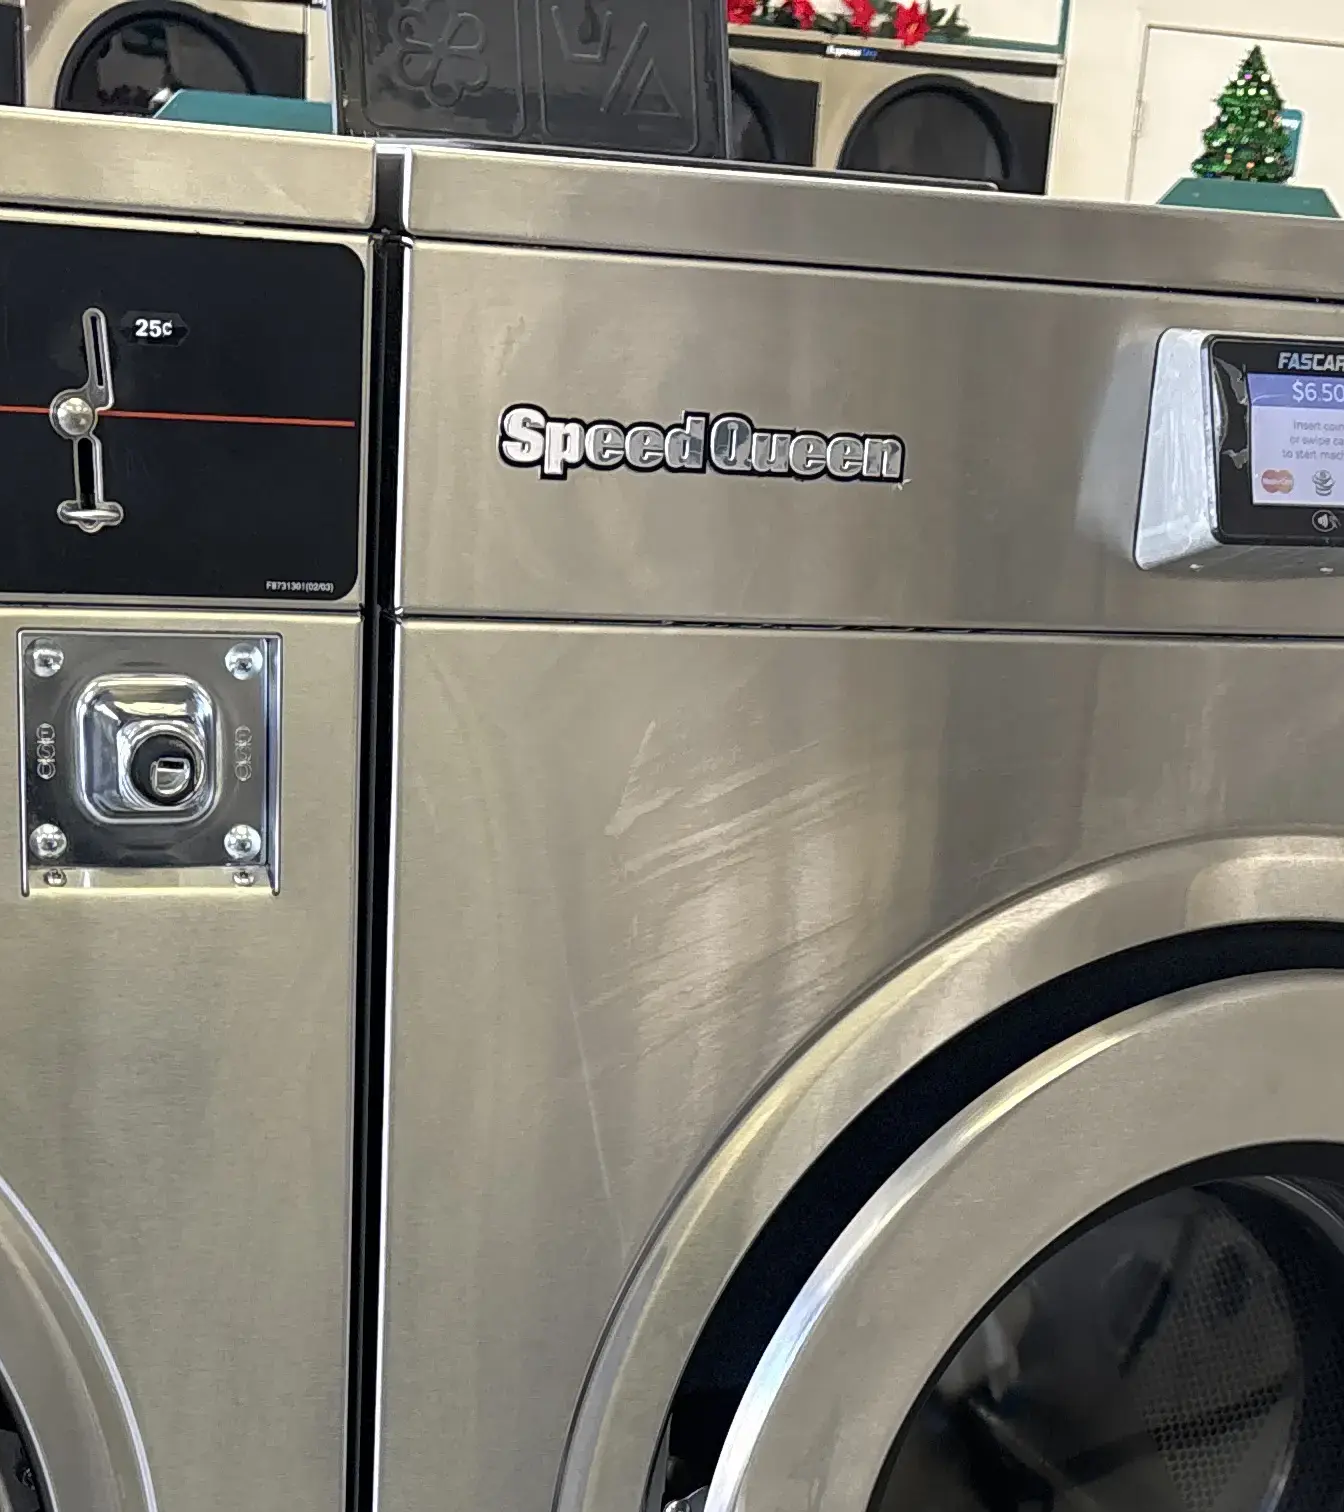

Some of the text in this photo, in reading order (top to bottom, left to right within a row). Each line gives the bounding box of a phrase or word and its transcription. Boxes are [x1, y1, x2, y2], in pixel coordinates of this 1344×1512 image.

[135, 318, 173, 338] 25¢
[499, 403, 906, 483] Speed Queen
